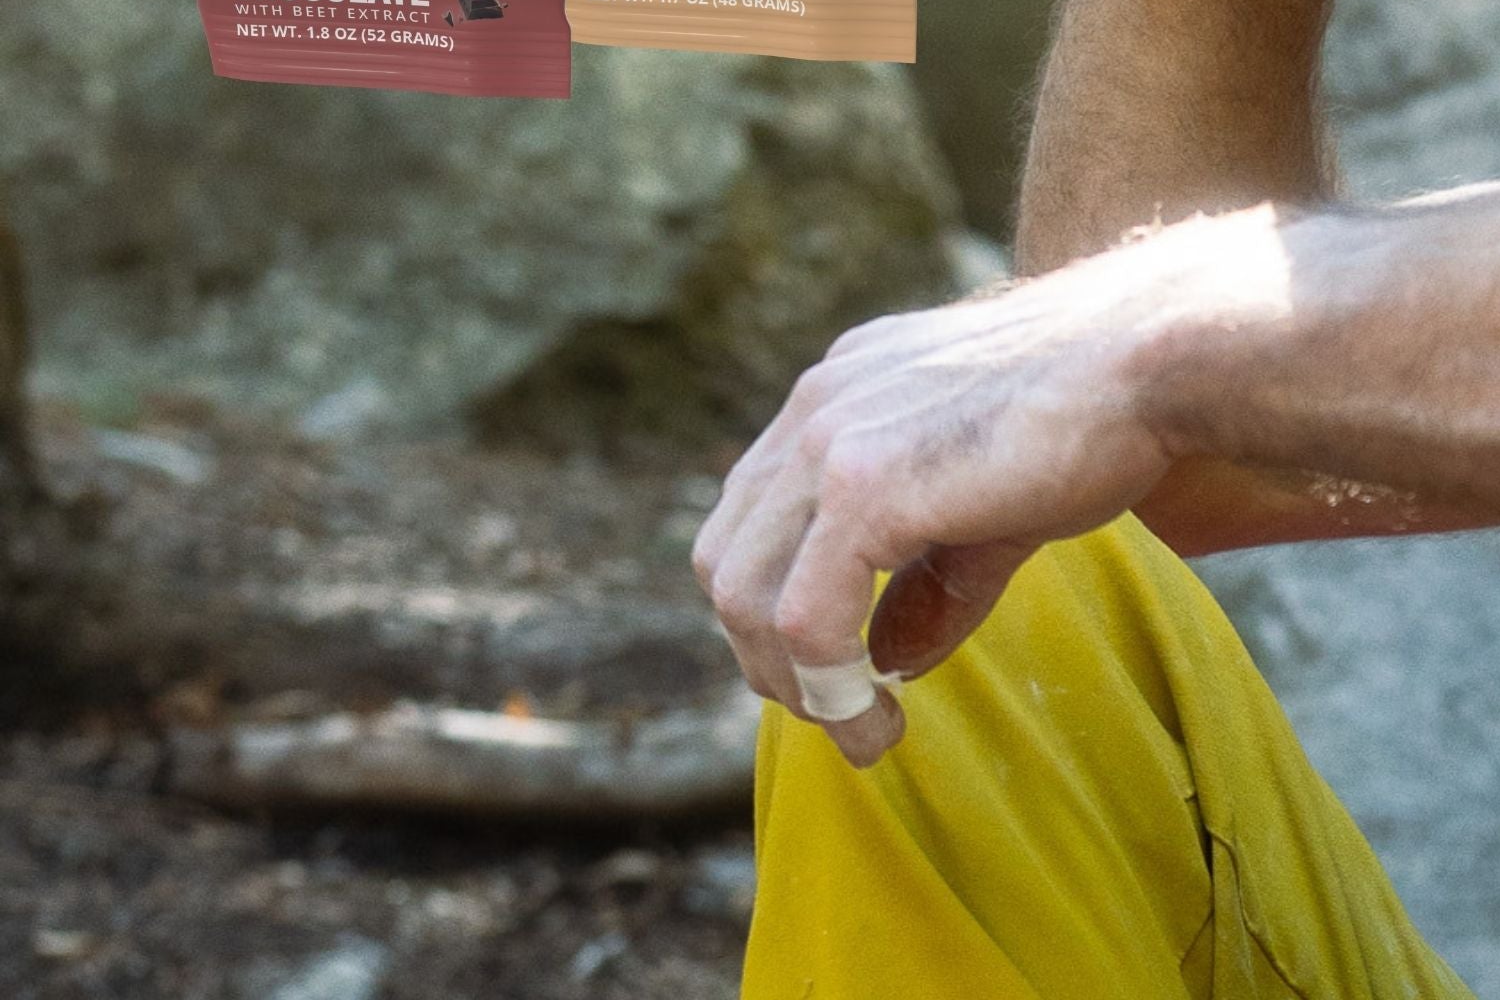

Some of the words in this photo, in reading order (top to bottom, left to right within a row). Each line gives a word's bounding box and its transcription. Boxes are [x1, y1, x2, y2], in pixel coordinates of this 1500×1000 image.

[235, 4, 282, 15] WITH
[293, 6, 336, 17] BEET
[348, 8, 430, 23] EXTRACT
[237, 24, 267, 37] NET
[272, 25, 301, 38] WT.
[307, 27, 329, 39] 1.8
[335, 28, 357, 40] OZ
[362, 29, 386, 44] (52
[391, 31, 454, 51] GRAMS)
